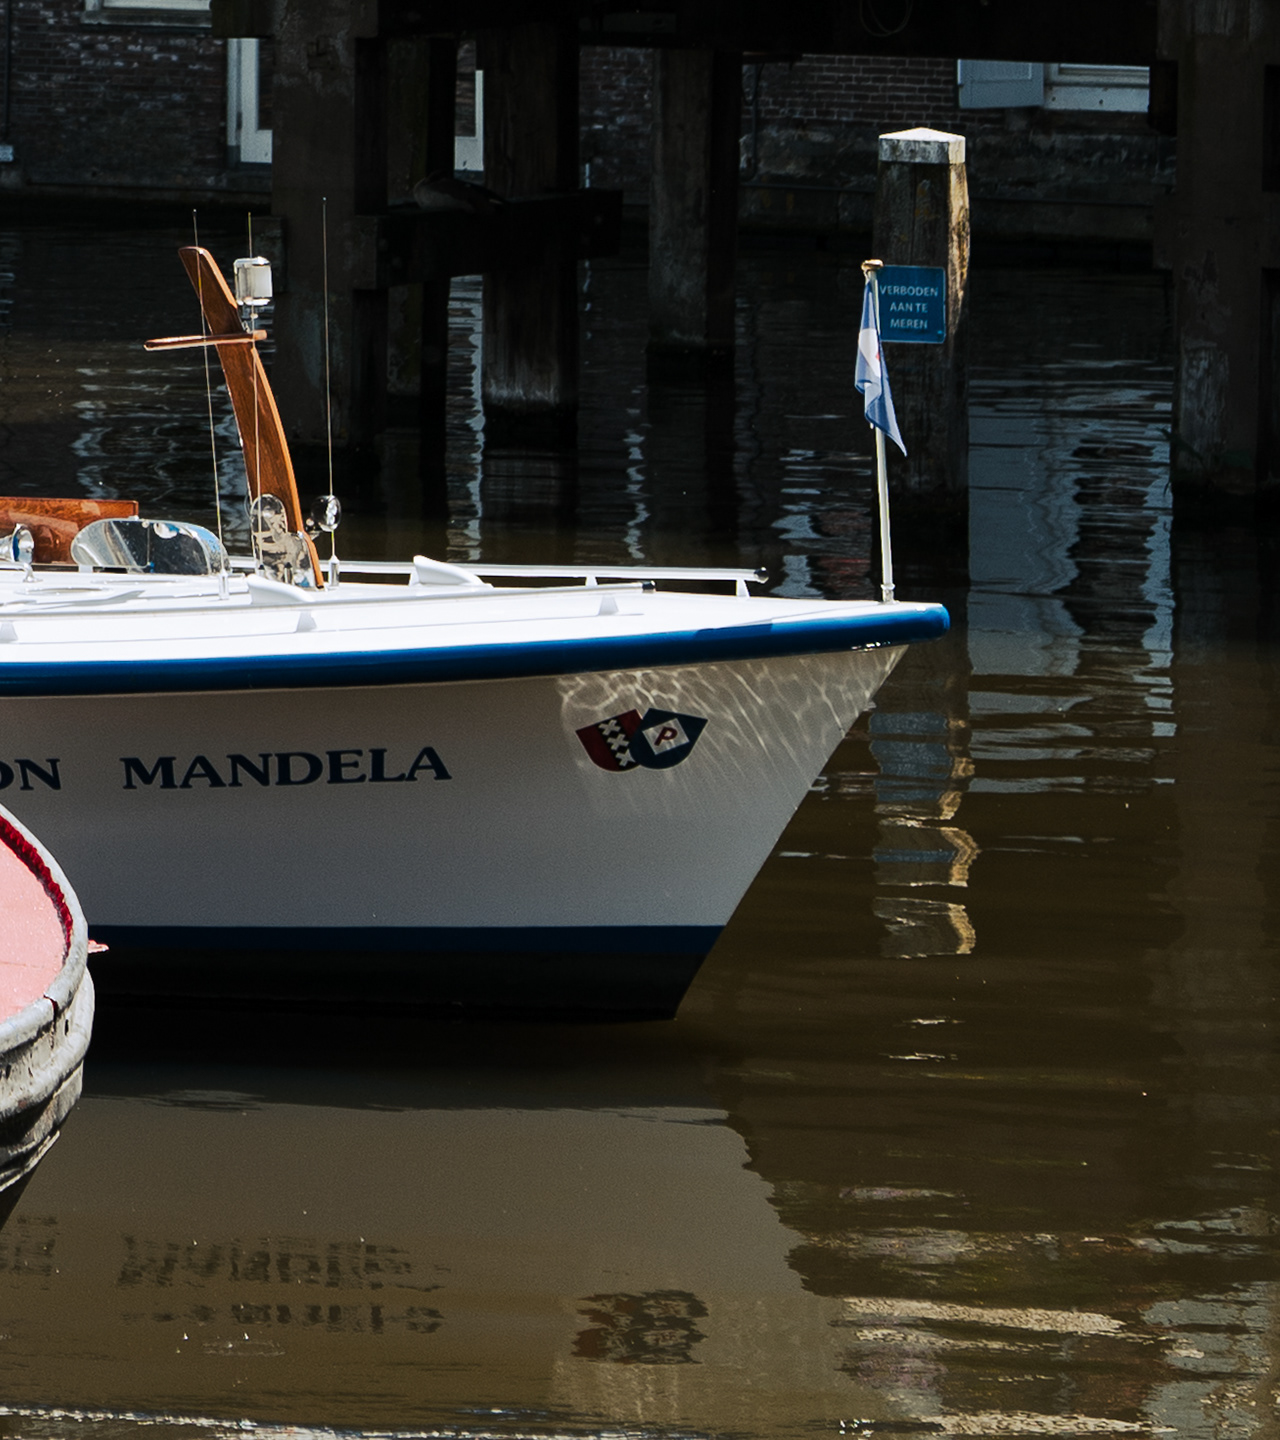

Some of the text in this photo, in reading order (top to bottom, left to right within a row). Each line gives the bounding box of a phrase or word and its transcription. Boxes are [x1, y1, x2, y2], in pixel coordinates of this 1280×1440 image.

[880, 285, 939, 297] VERBODEN
[889, 302, 928, 313] AAN TE
[890, 318, 928, 329] MEREN
[119, 746, 453, 789] MANDELA
